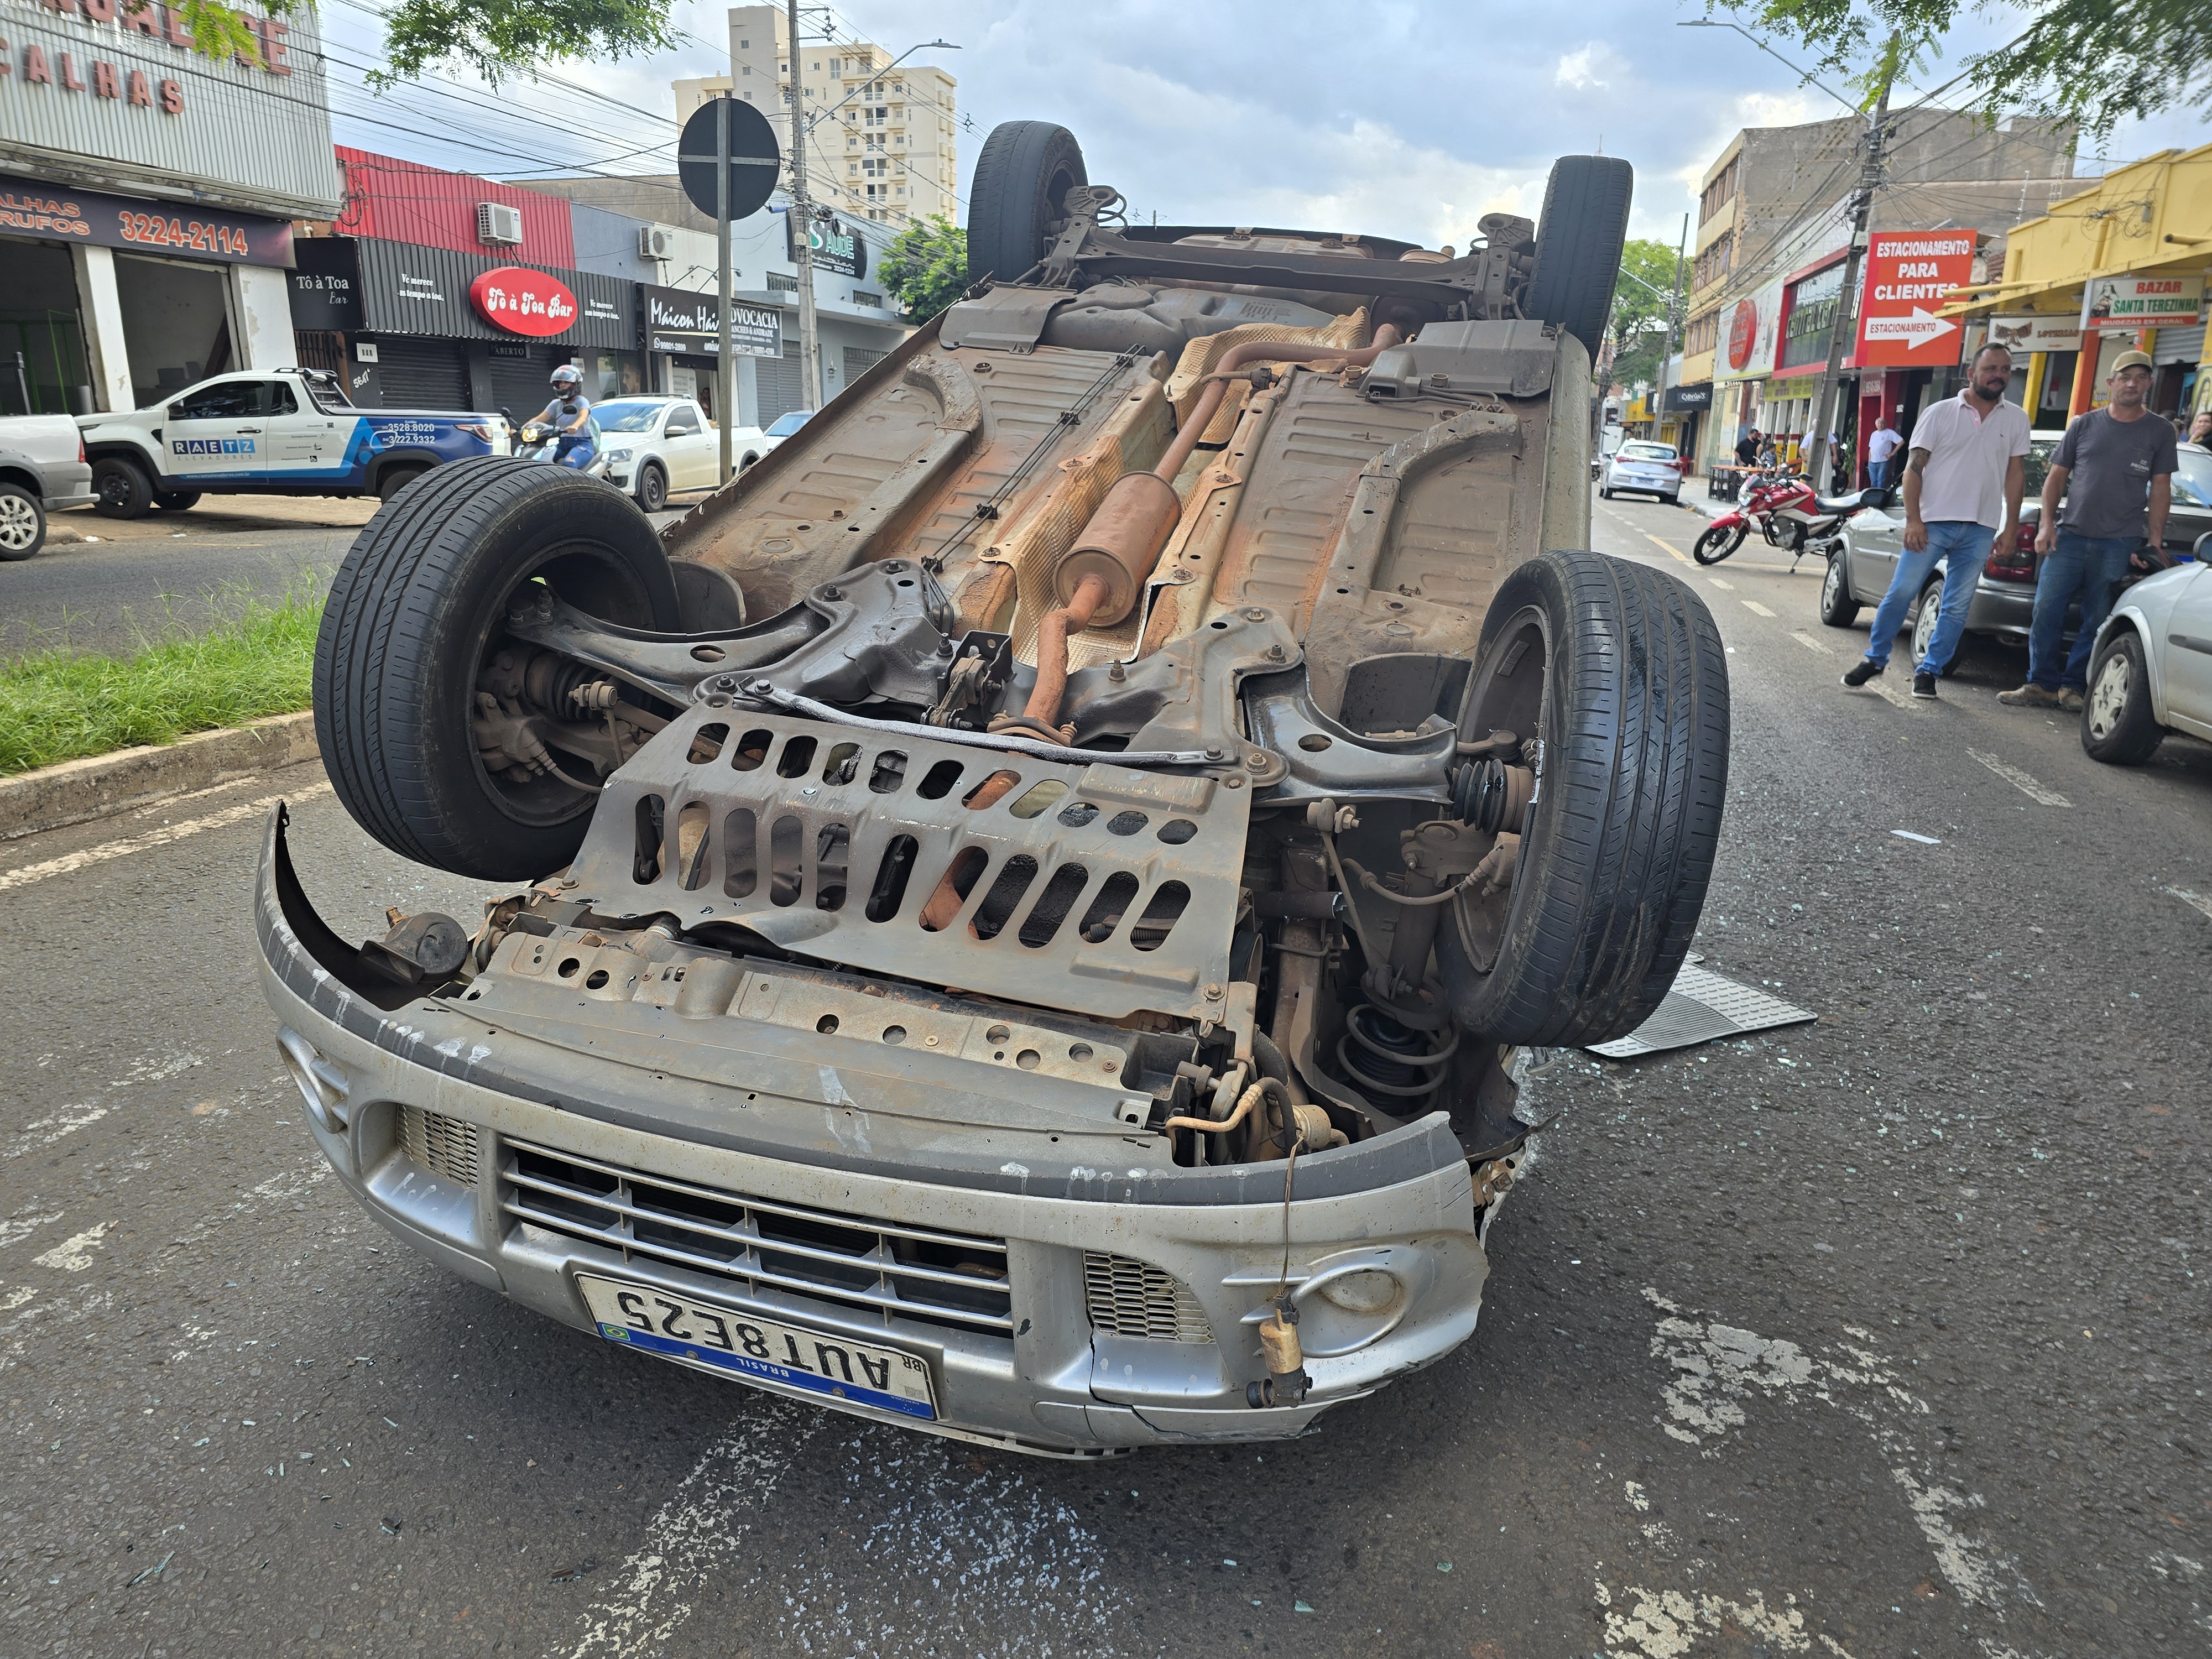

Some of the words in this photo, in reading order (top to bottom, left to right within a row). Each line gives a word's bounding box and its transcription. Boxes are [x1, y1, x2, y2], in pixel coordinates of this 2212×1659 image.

[119, 210, 248, 256] 3224-2114
[1877, 239, 1969, 257] ESTACIONAMENTO
[1898, 262, 1938, 278] PARA
[296, 275, 312, 289] Tô
[316, 275, 324, 289] à
[325, 276, 349, 289] Toa
[2136, 281, 2182, 294] BAZAR
[329, 291, 348, 304] Bar
[406, 290, 425, 300] tempo
[521, 291, 545, 315] Toa
[547, 294, 572, 318] Bar
[2114, 299, 2144, 314] SANTA
[2147, 298, 2198, 313] TEREZINHA
[651, 298, 694, 328] Maicon
[731, 307, 778, 328] DVOCACIA
[1870, 322, 1936, 333] ESTACIONAMENTO
[495, 347, 524, 356] ABERTO
[388, 423, 435, 432] 3528.8020
[175, 441, 252, 453] RAETZ
[617, 1291, 889, 1390] AUT8E25
[736, 1358, 790, 1378] BRASIL
[902, 1357, 922, 1372] BR
